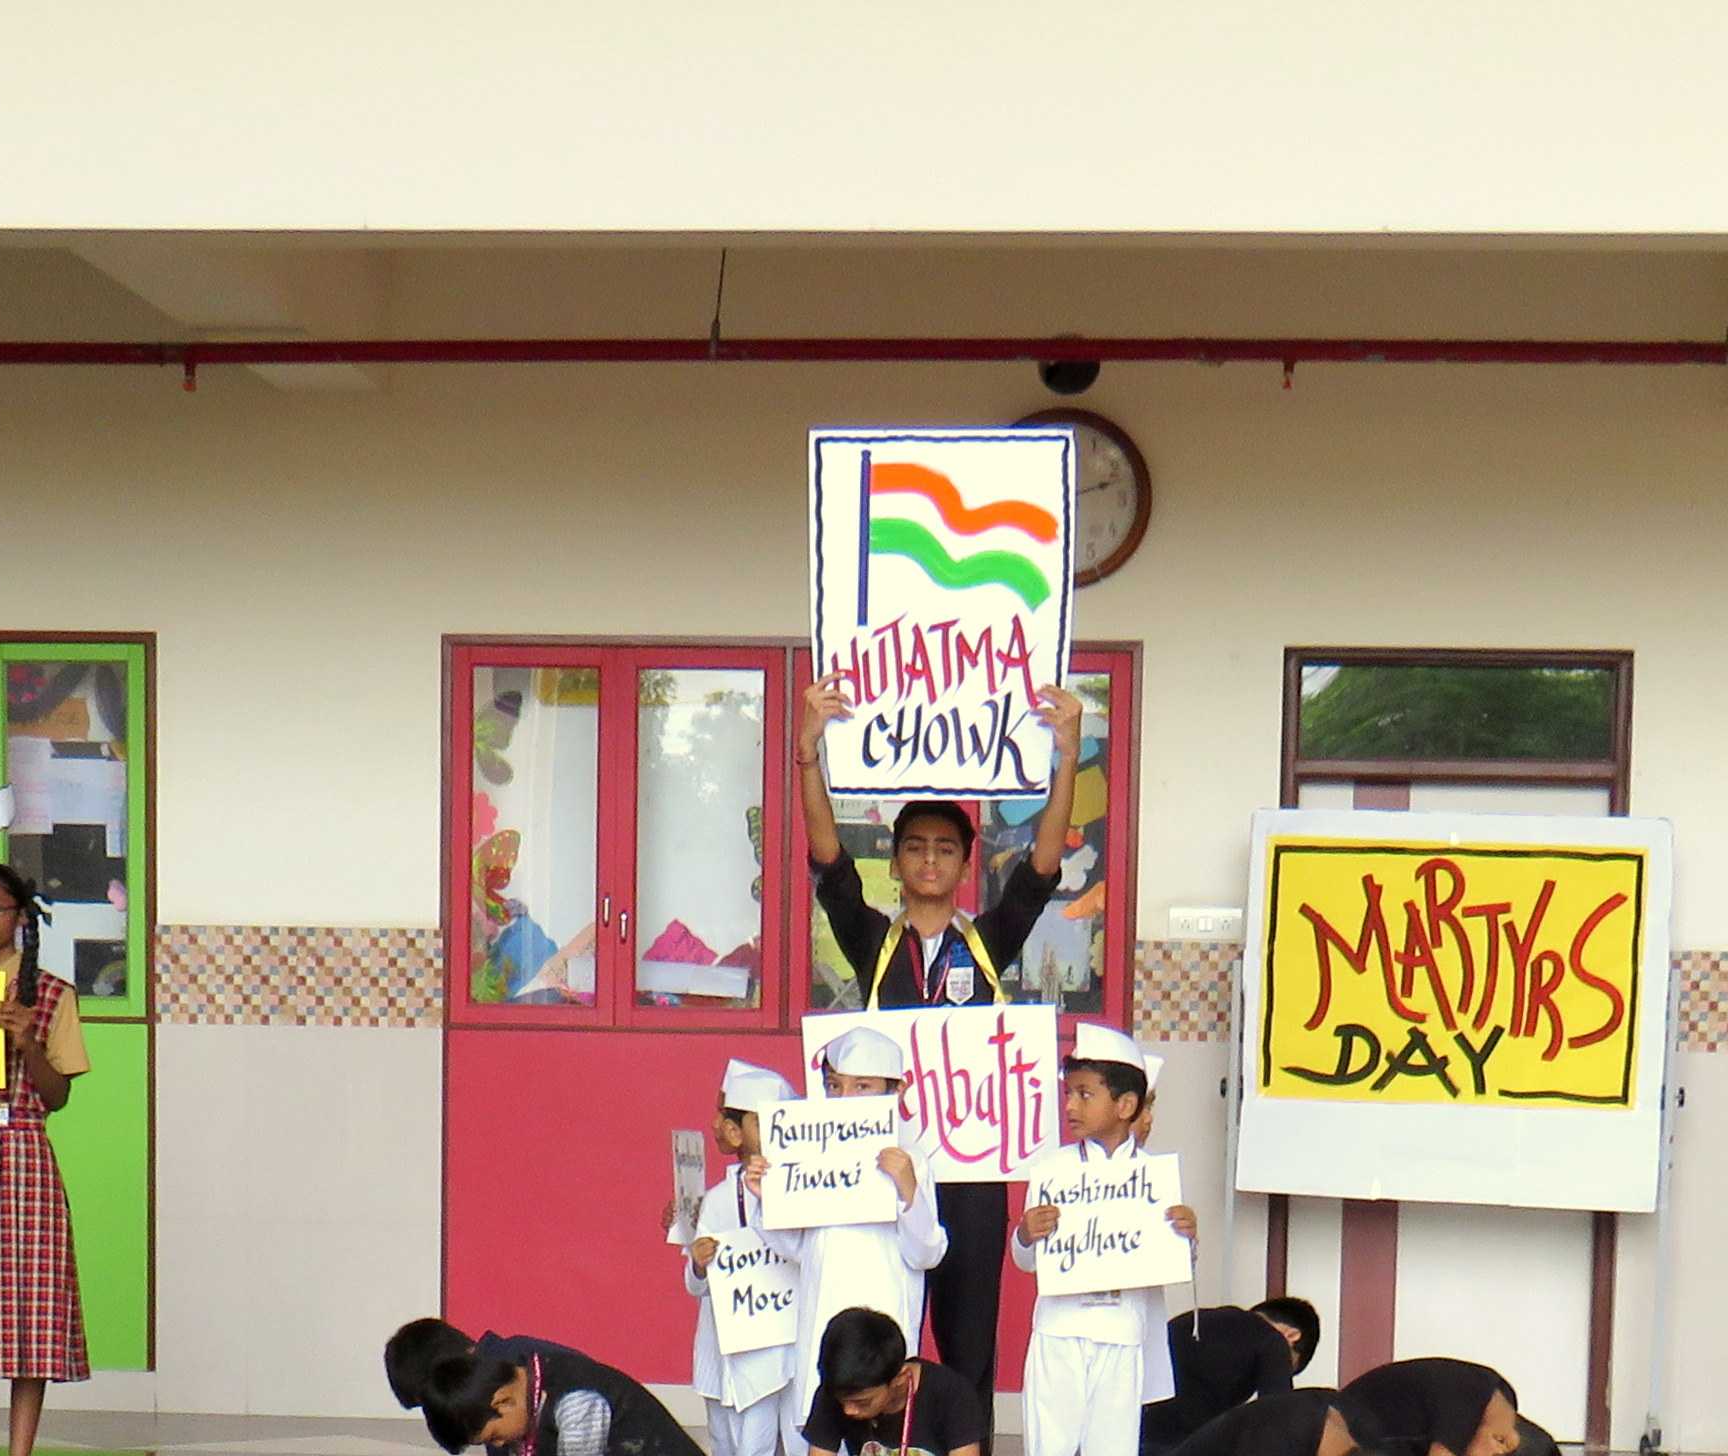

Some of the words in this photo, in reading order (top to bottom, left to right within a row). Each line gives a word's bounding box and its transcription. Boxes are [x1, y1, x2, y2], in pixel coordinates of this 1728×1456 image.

[831, 612, 1039, 708] HUTATMA
[861, 692, 1048, 789] CHOWK
[1299, 858, 1628, 1061] MARTYRS
[1282, 1022, 1505, 1098] DAY
[770, 1109, 894, 1153] Ramprasad
[781, 1161, 862, 1193] Tiwari
[1038, 1164, 1161, 1205] Kashinath
[733, 1284, 793, 1316] More
